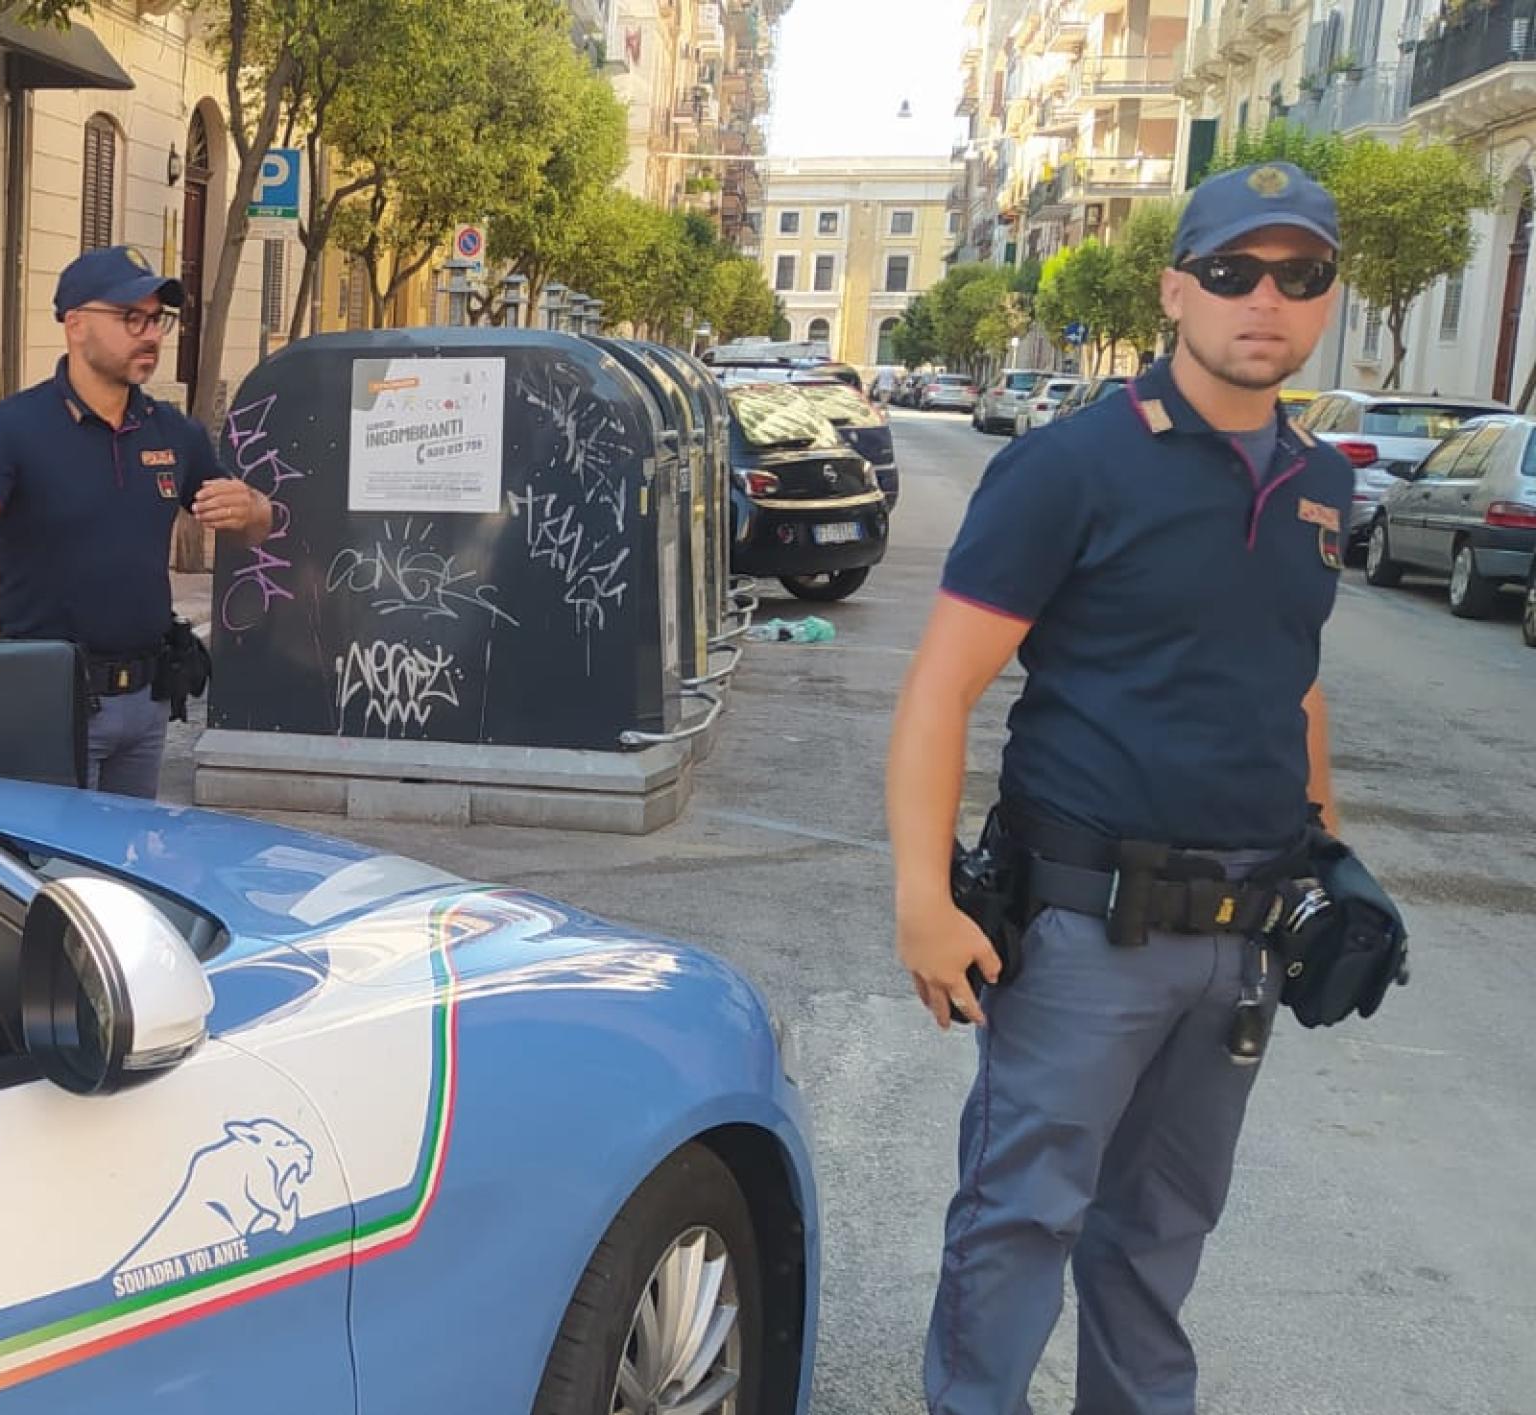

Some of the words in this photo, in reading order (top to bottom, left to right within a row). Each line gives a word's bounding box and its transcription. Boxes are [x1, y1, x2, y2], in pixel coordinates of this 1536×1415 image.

[253, 153, 289, 202] P
[366, 418, 463, 449] INGOMBRANTI
[113, 1257, 185, 1297] SQUADRA
[185, 1239, 249, 1274] VOLANTE
